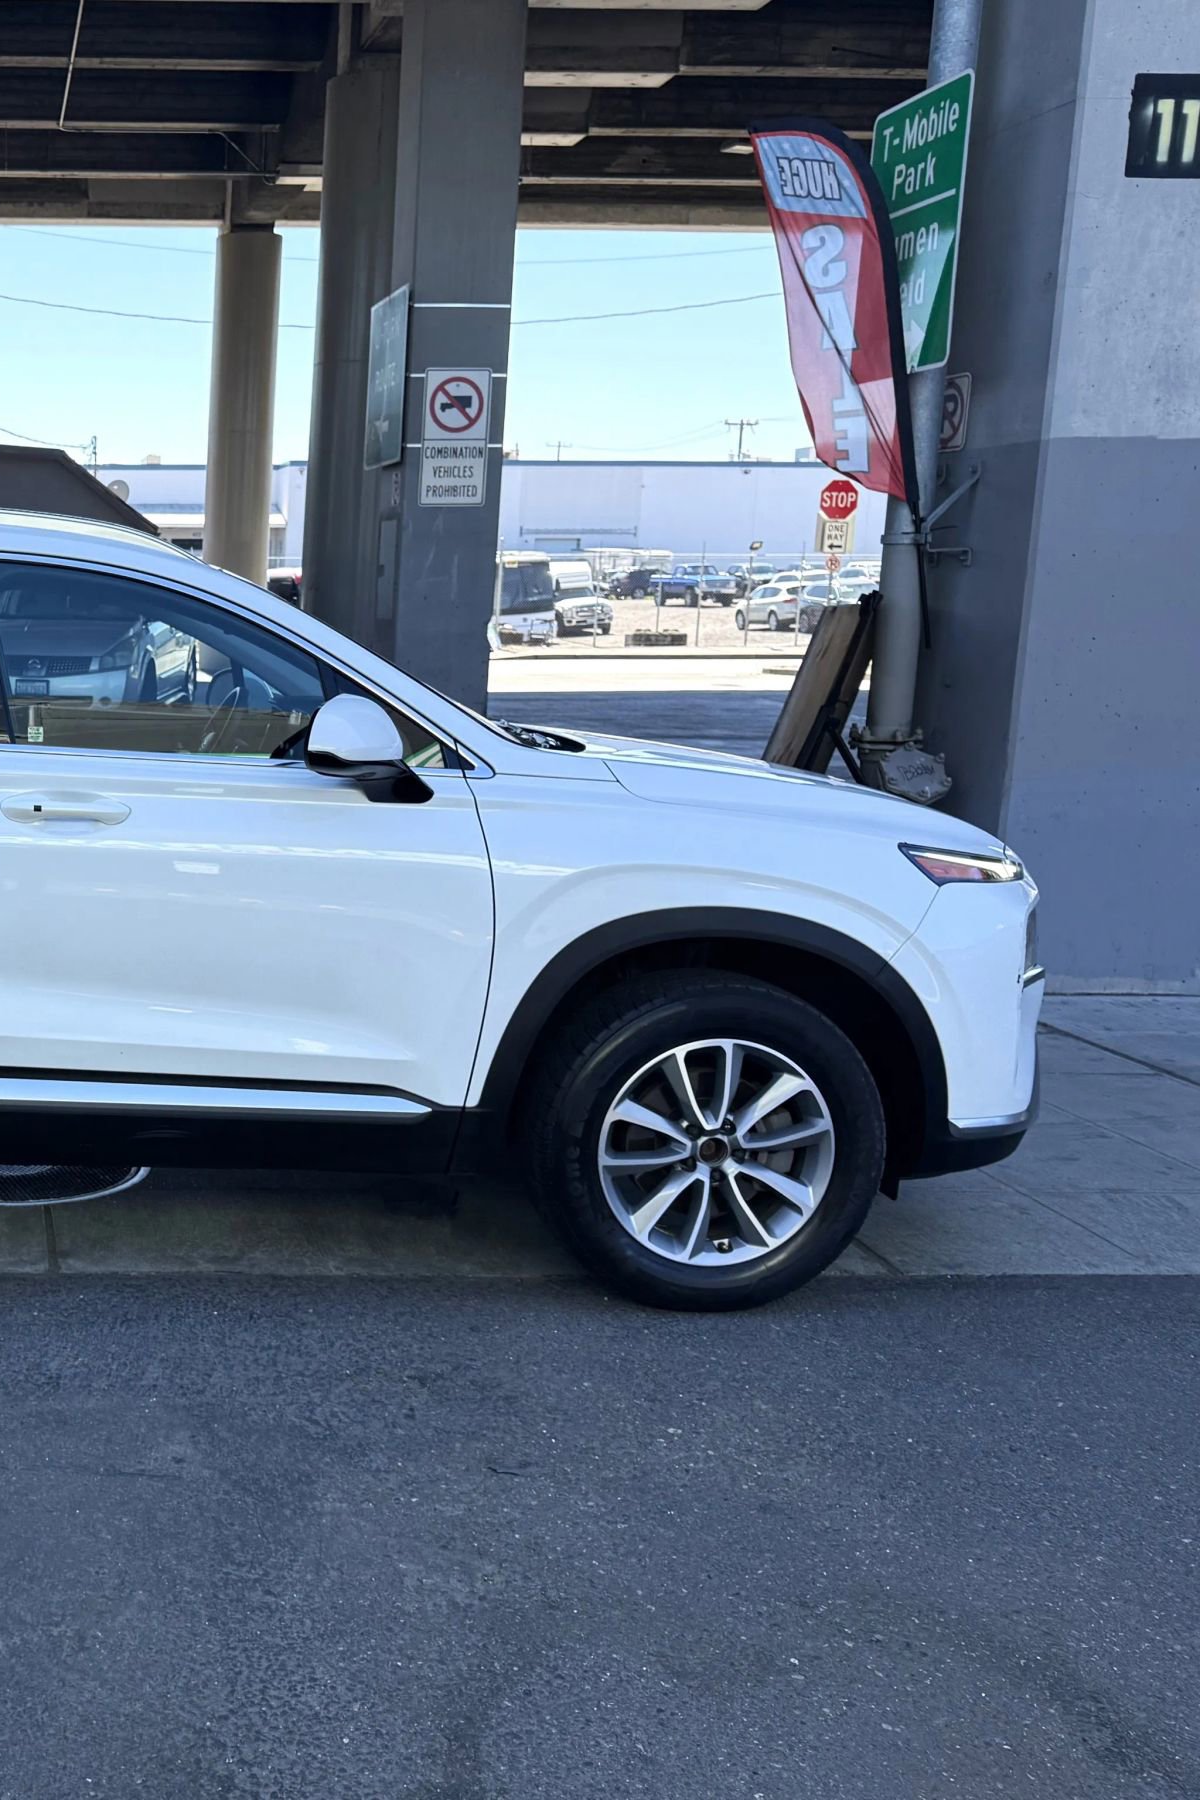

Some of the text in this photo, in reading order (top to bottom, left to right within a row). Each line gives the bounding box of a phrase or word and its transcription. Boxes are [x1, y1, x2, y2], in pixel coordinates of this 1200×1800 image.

[882, 98, 960, 164] T-Mobile
[891, 151, 937, 201] Park
[894, 221, 939, 262] men
[899, 267, 926, 308] eld
[424, 446, 484, 460] COMBINATION
[432, 465, 474, 479] VEHICLES
[425, 484, 478, 498] PROHIBITED
[821, 491, 856, 508] STOP
[828, 524, 845, 533] ONE
[827, 533, 844, 541] WAY
